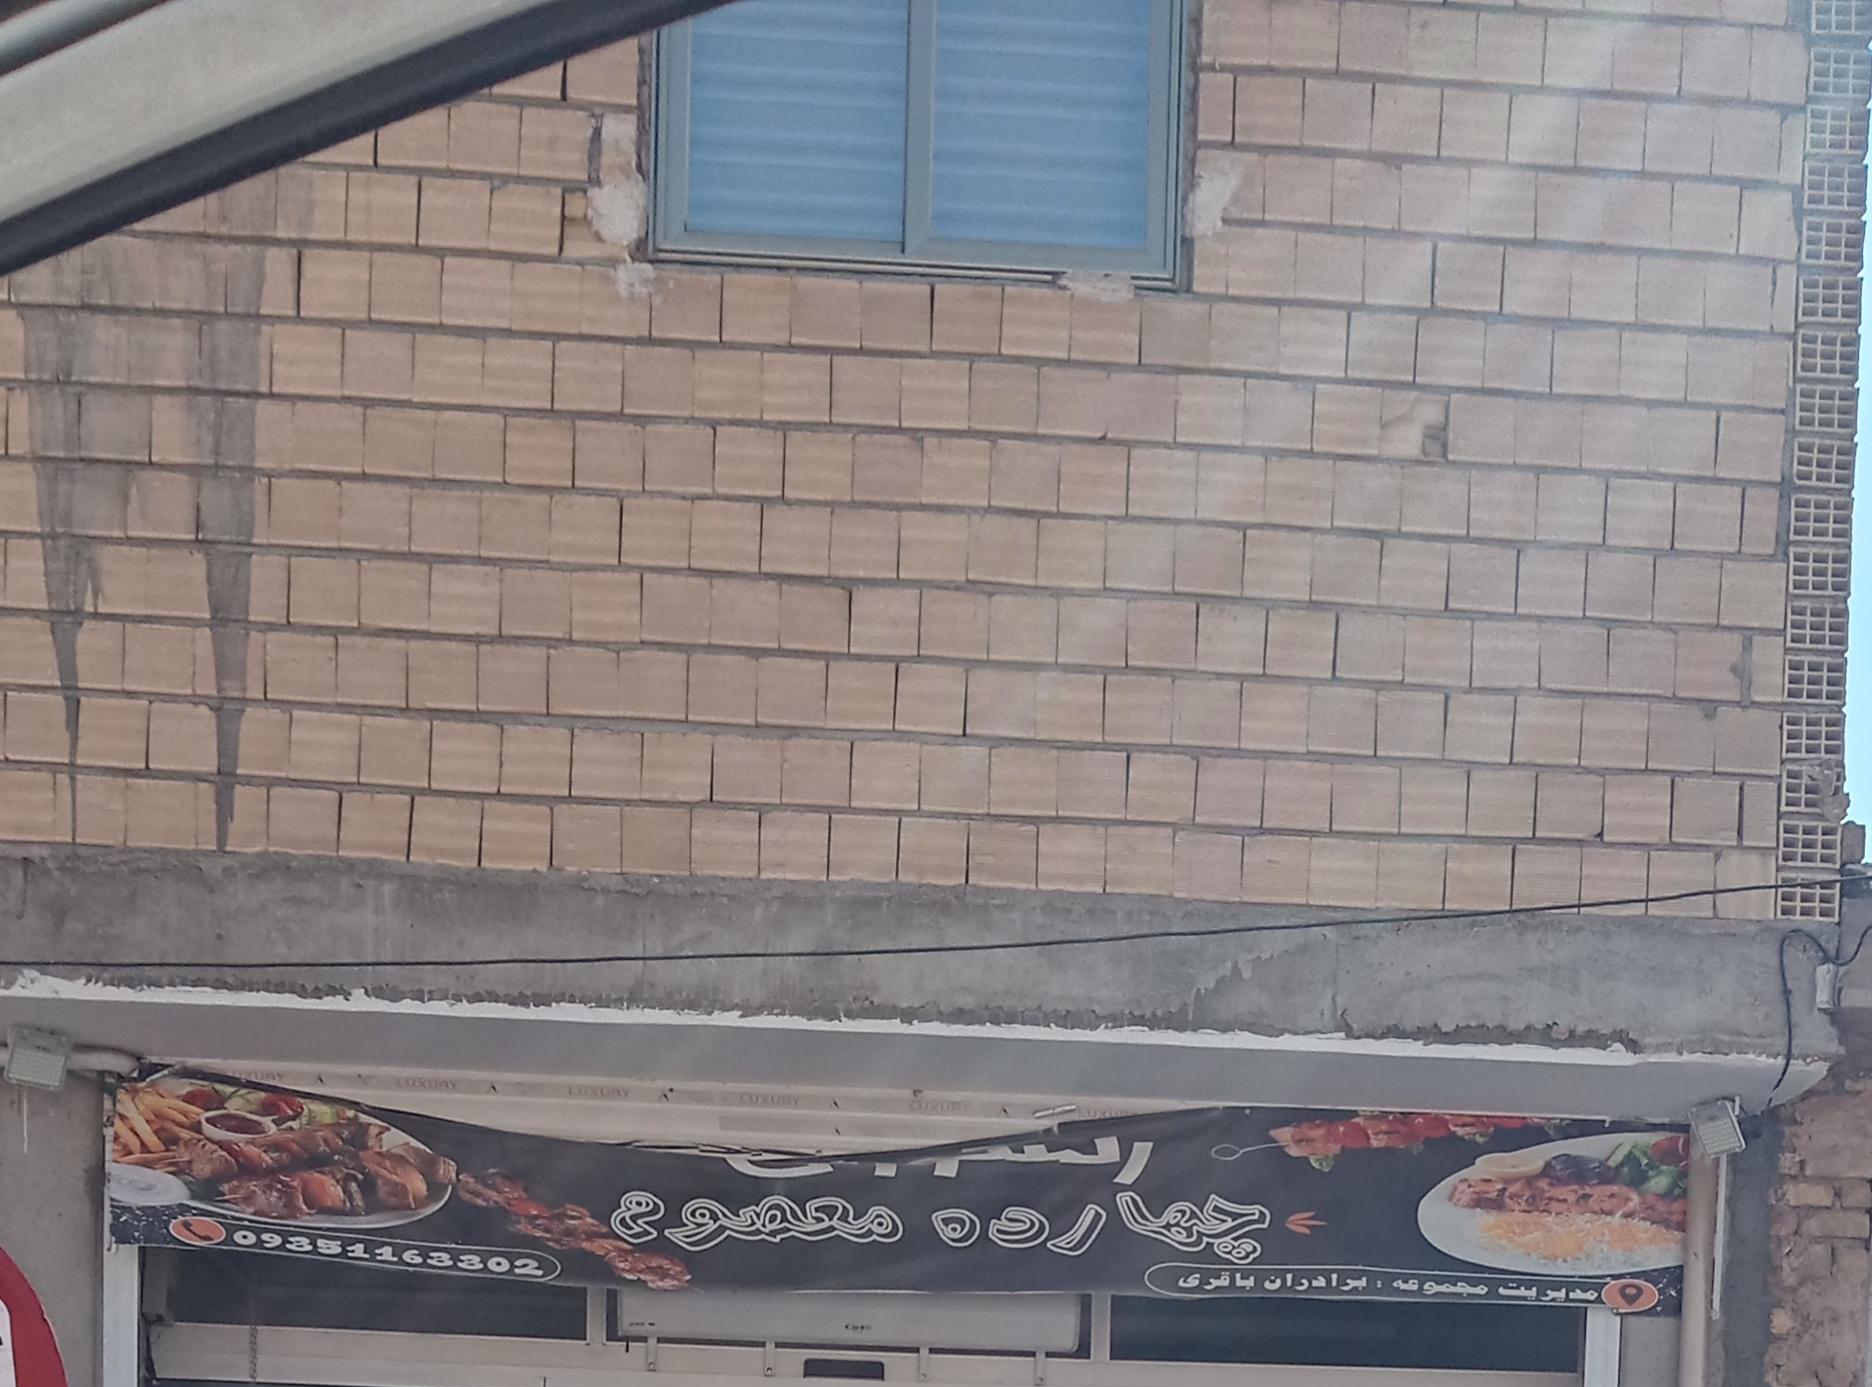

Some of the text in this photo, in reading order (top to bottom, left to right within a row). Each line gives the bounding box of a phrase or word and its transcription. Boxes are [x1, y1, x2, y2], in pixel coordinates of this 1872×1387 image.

[610, 1190, 1270, 1263] چهارده معصوم
[232, 1229, 544, 1277] 09351163302
[1177, 1271, 1255, 1290] باقری
[1263, 1272, 1368, 1291] برادران
[1392, 1279, 1489, 1297] مجموعه
[1498, 1282, 1599, 1300] مدیریت
